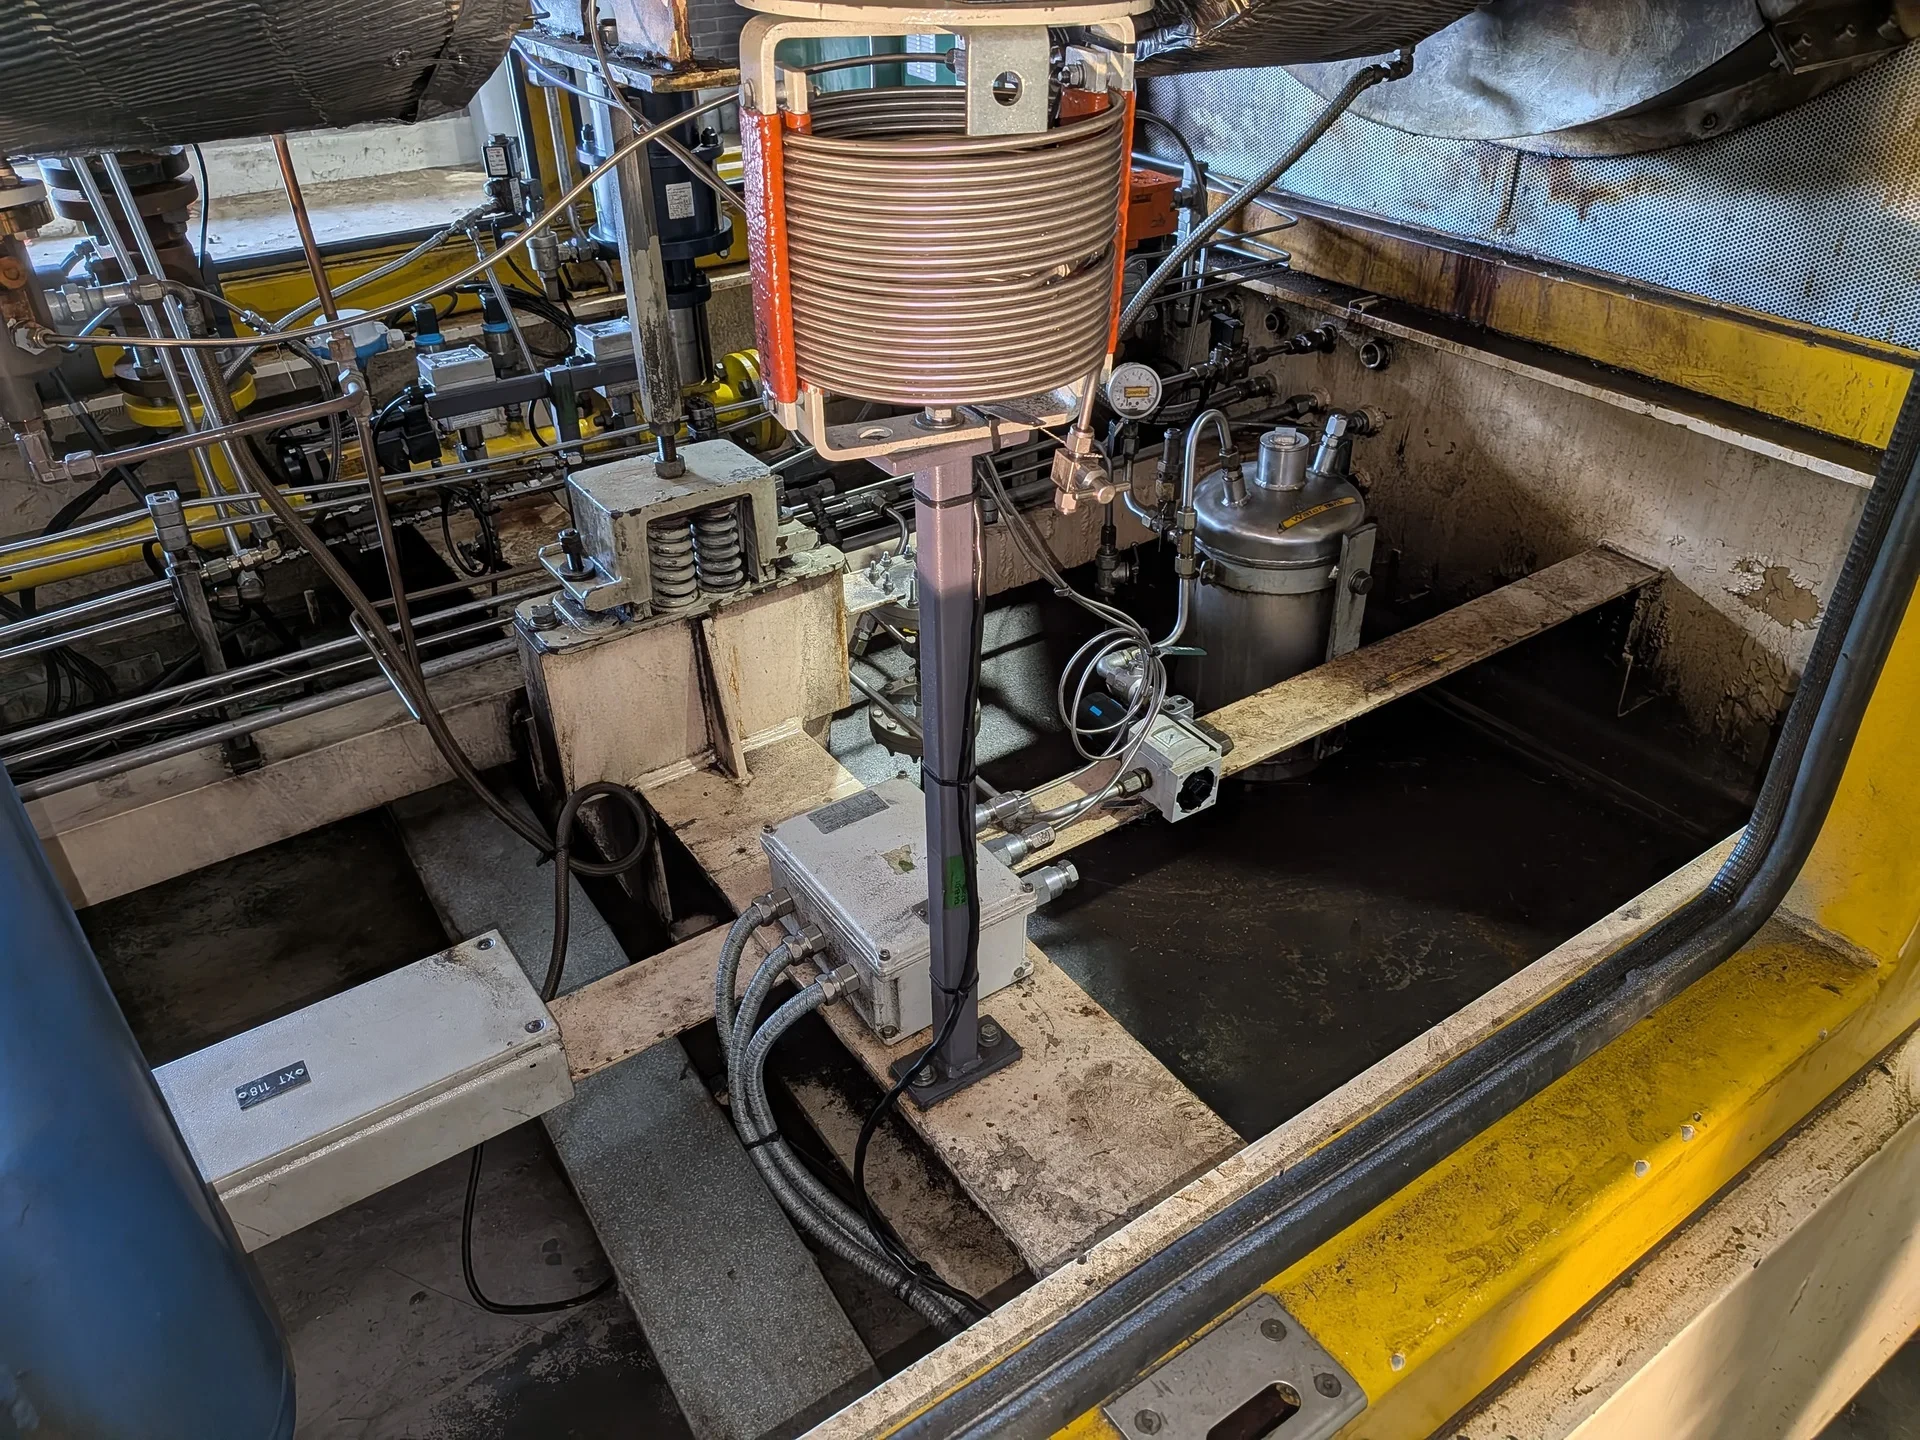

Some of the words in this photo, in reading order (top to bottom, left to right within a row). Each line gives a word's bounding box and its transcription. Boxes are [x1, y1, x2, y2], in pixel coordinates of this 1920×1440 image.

[1291, 507, 1322, 521] Water
[279, 1071, 295, 1085] XT
[250, 1082, 270, 1096] 118
